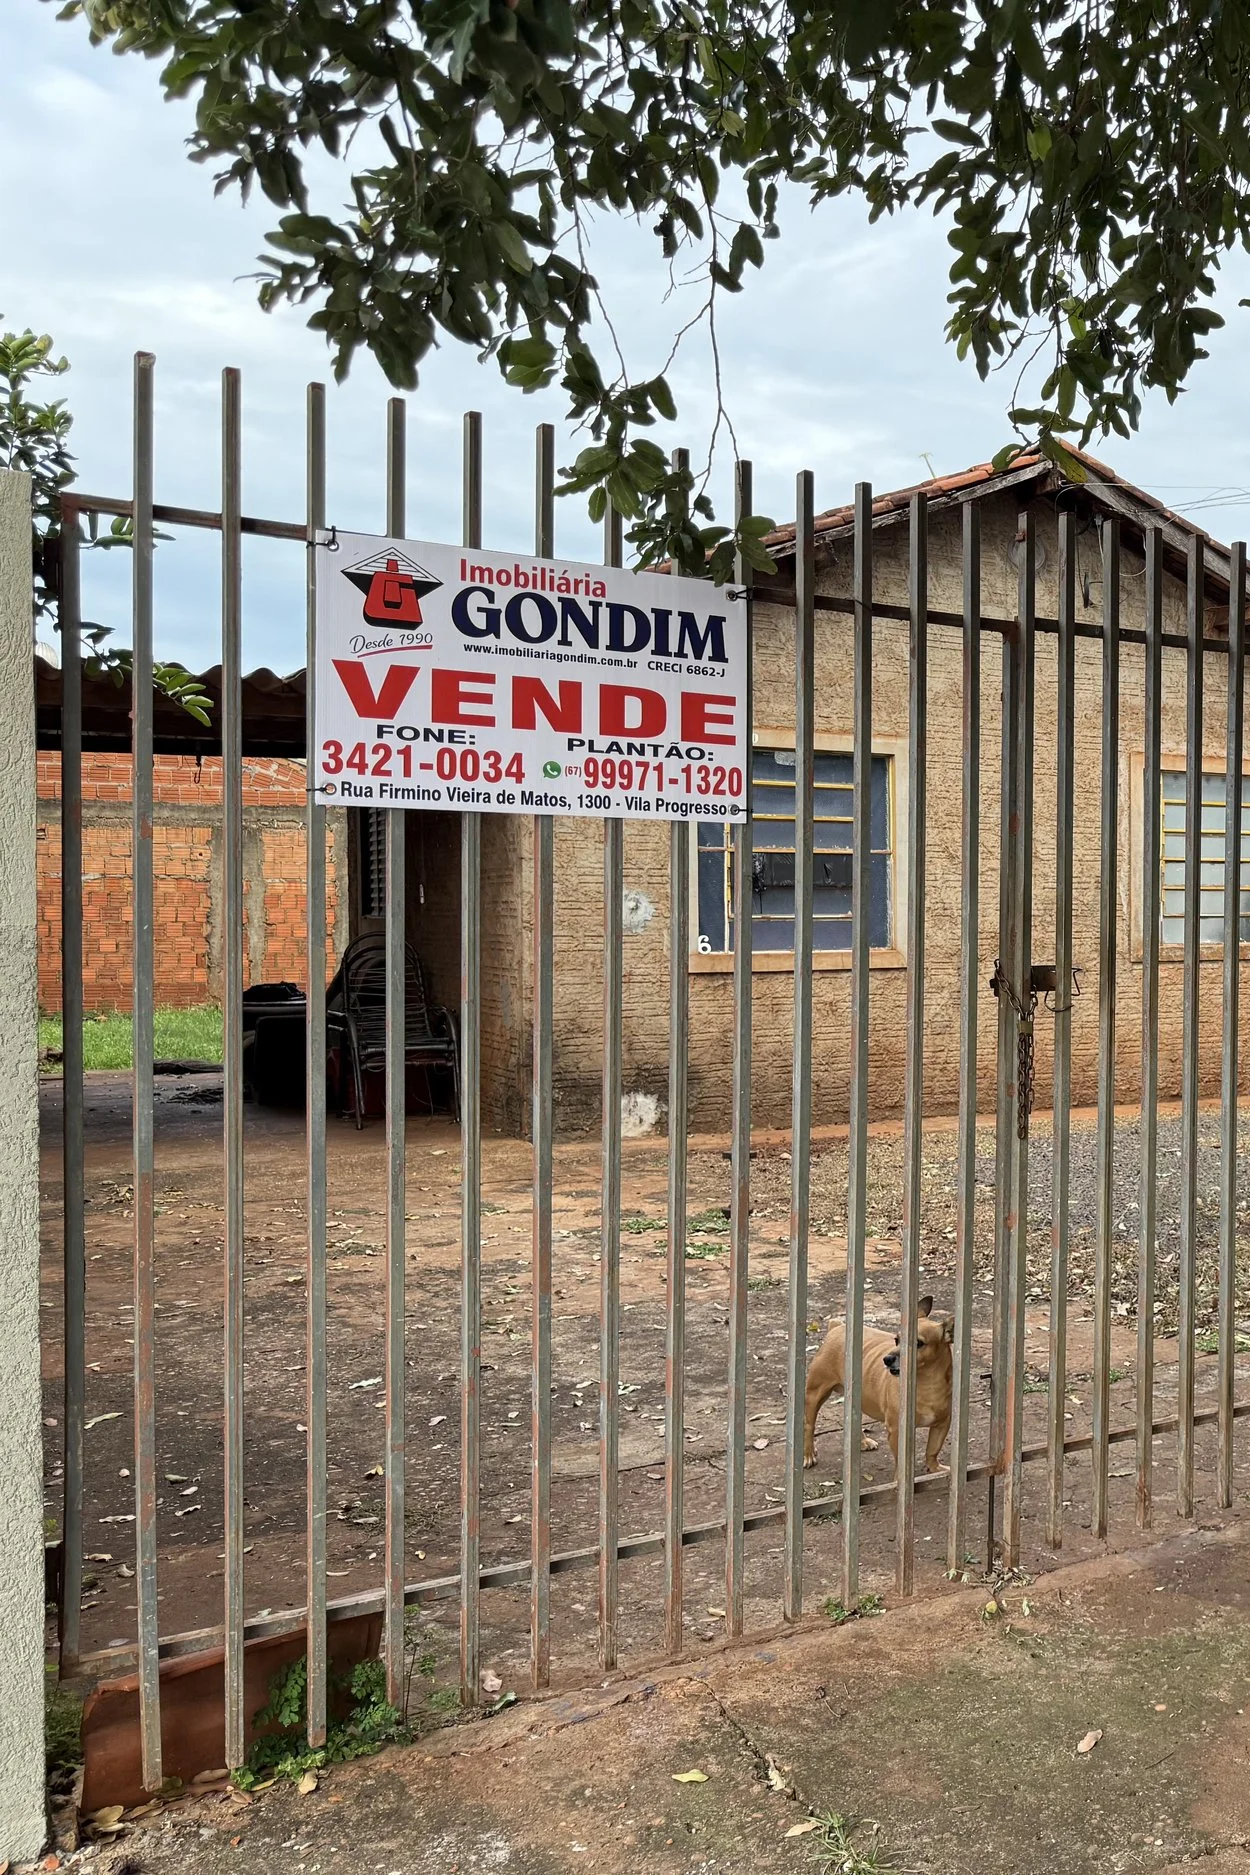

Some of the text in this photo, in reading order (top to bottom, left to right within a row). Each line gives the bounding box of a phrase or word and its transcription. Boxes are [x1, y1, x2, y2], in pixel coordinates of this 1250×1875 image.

[460, 558, 607, 598] Imobiliária
[451, 585, 729, 664] GONDIM
[350, 632, 433, 654] Desde 1990
[463, 644, 638, 669] www.imobiliariagondim.com.br
[647, 661, 726, 678] CRECI 6862-J
[331, 659, 737, 746] VENDE
[376, 724, 476, 745] FONE:
[567, 738, 714, 761] PLANTÃO:
[322, 740, 526, 785] 3421-0034
[564, 757, 743, 798] (67) 99971-1320
[341, 781, 374, 799] Rua
[379, 783, 442, 801] Firmino
[447, 786, 491, 804] Vieira
[496, 789, 515, 805] de
[520, 790, 572, 810] Matos,
[577, 793, 611, 810] 1300
[625, 796, 651, 812] Vila
[655, 798, 727, 816] Progresso
[698, 935, 712, 954] 6
